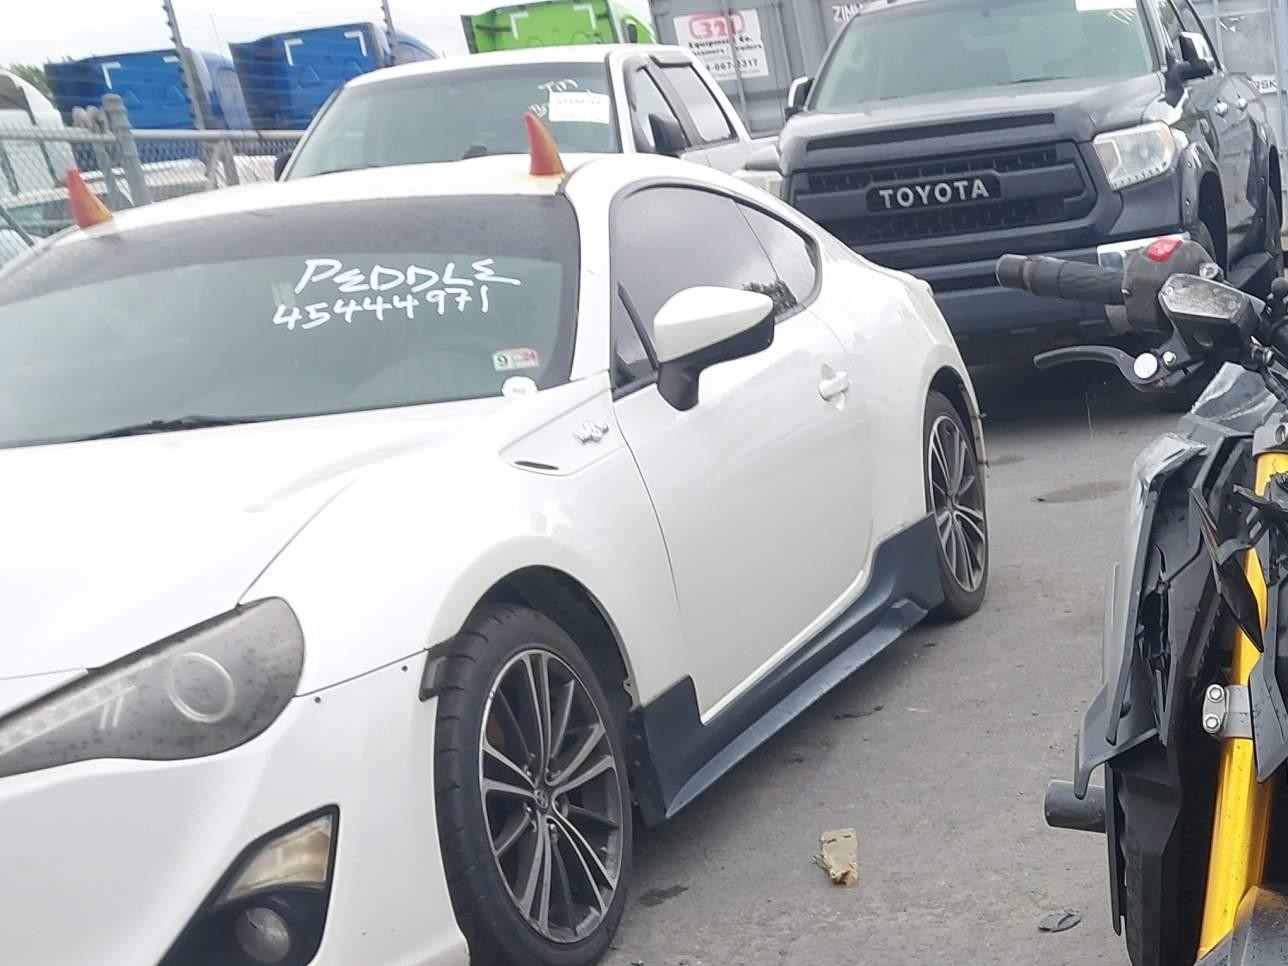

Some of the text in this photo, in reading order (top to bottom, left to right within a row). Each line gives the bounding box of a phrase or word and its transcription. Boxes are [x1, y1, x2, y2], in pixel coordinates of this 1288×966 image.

[700, 18, 737, 38] 321
[878, 178, 990, 208] TOYOTA
[294, 257, 522, 294] PEDDLE
[272, 284, 490, 330] 45444971
